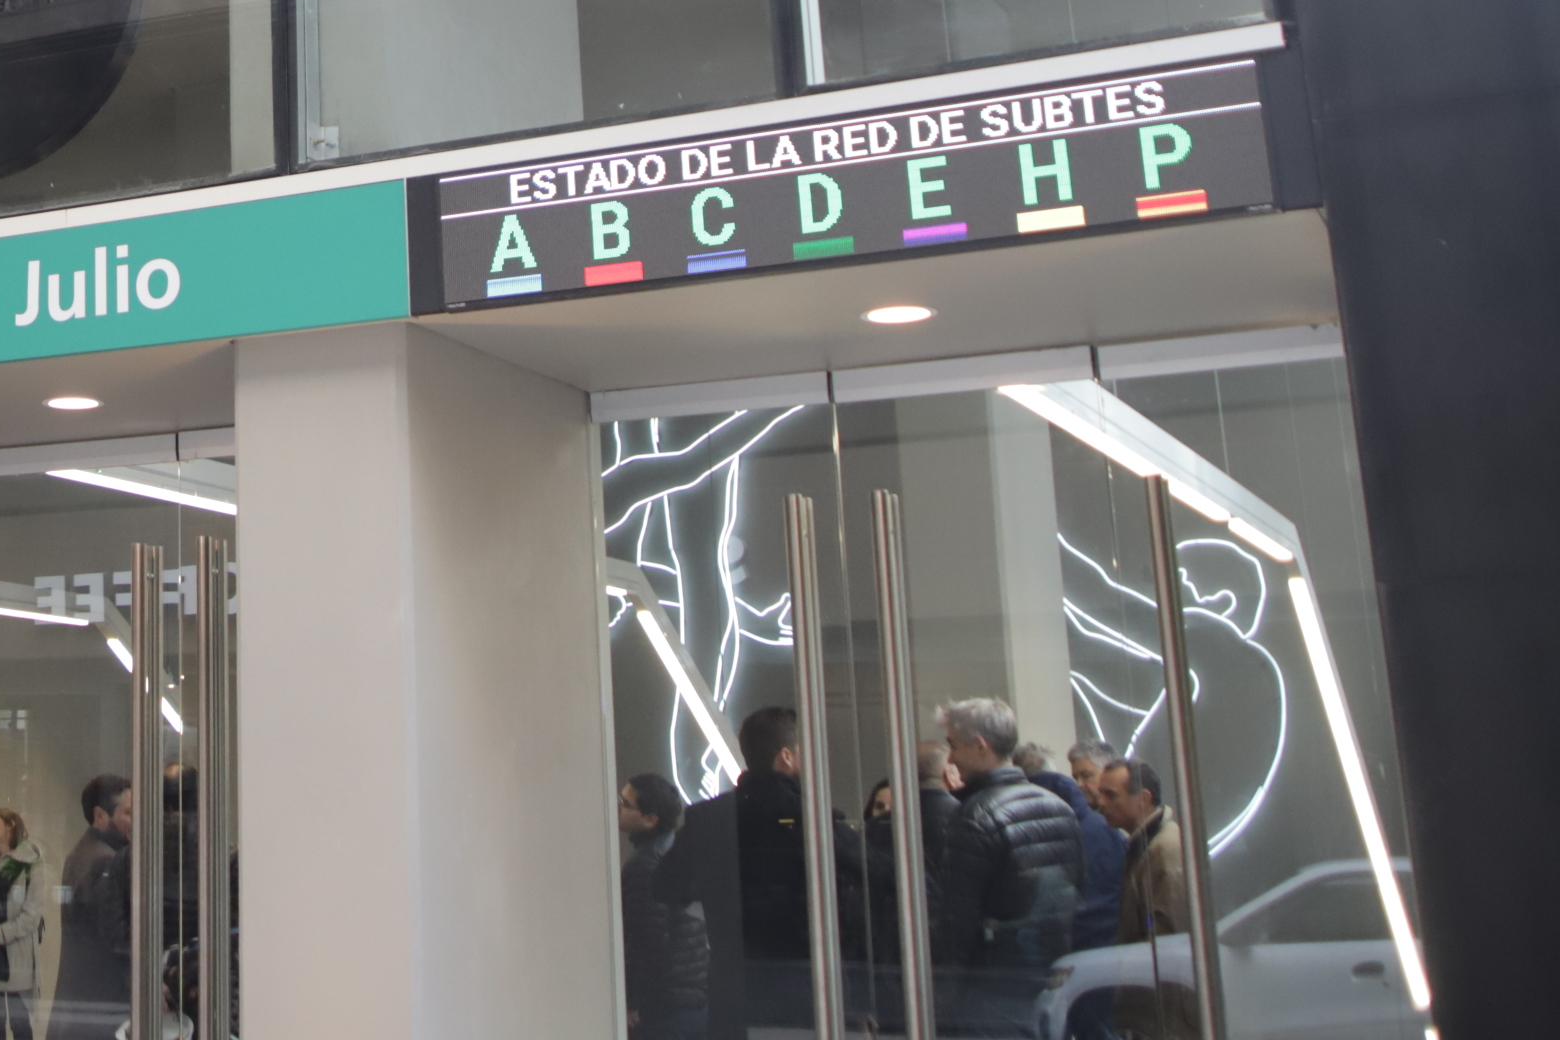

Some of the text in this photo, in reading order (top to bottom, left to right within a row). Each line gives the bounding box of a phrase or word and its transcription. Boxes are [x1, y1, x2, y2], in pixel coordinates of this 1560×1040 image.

[489, 122, 1193, 273] A B C D E H P
[509, 80, 1166, 205] ESTADO DE LA RED DE SUBTES
[14, 244, 181, 327] Julio
